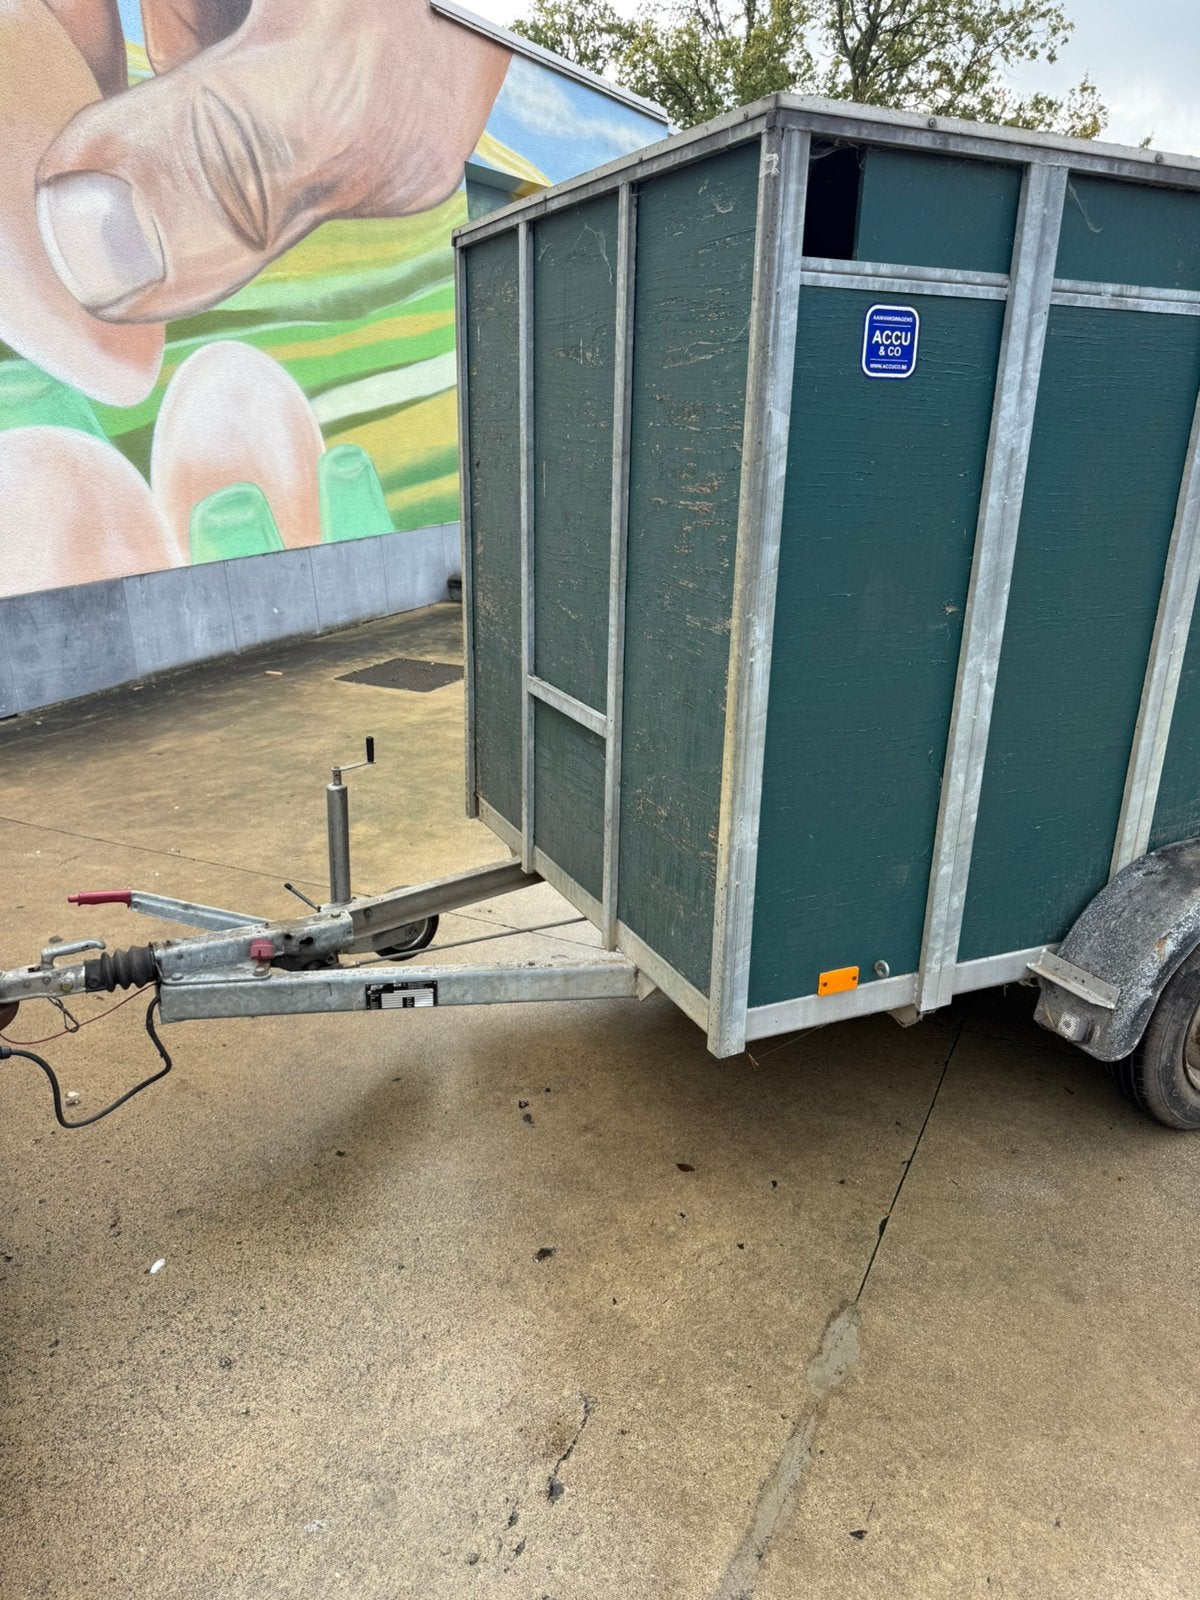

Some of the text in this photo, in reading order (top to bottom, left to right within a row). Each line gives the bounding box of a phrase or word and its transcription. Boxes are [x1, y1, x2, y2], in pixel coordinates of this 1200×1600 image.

[872, 330, 911, 346] ACCU
[879, 346, 902, 357] & CO
